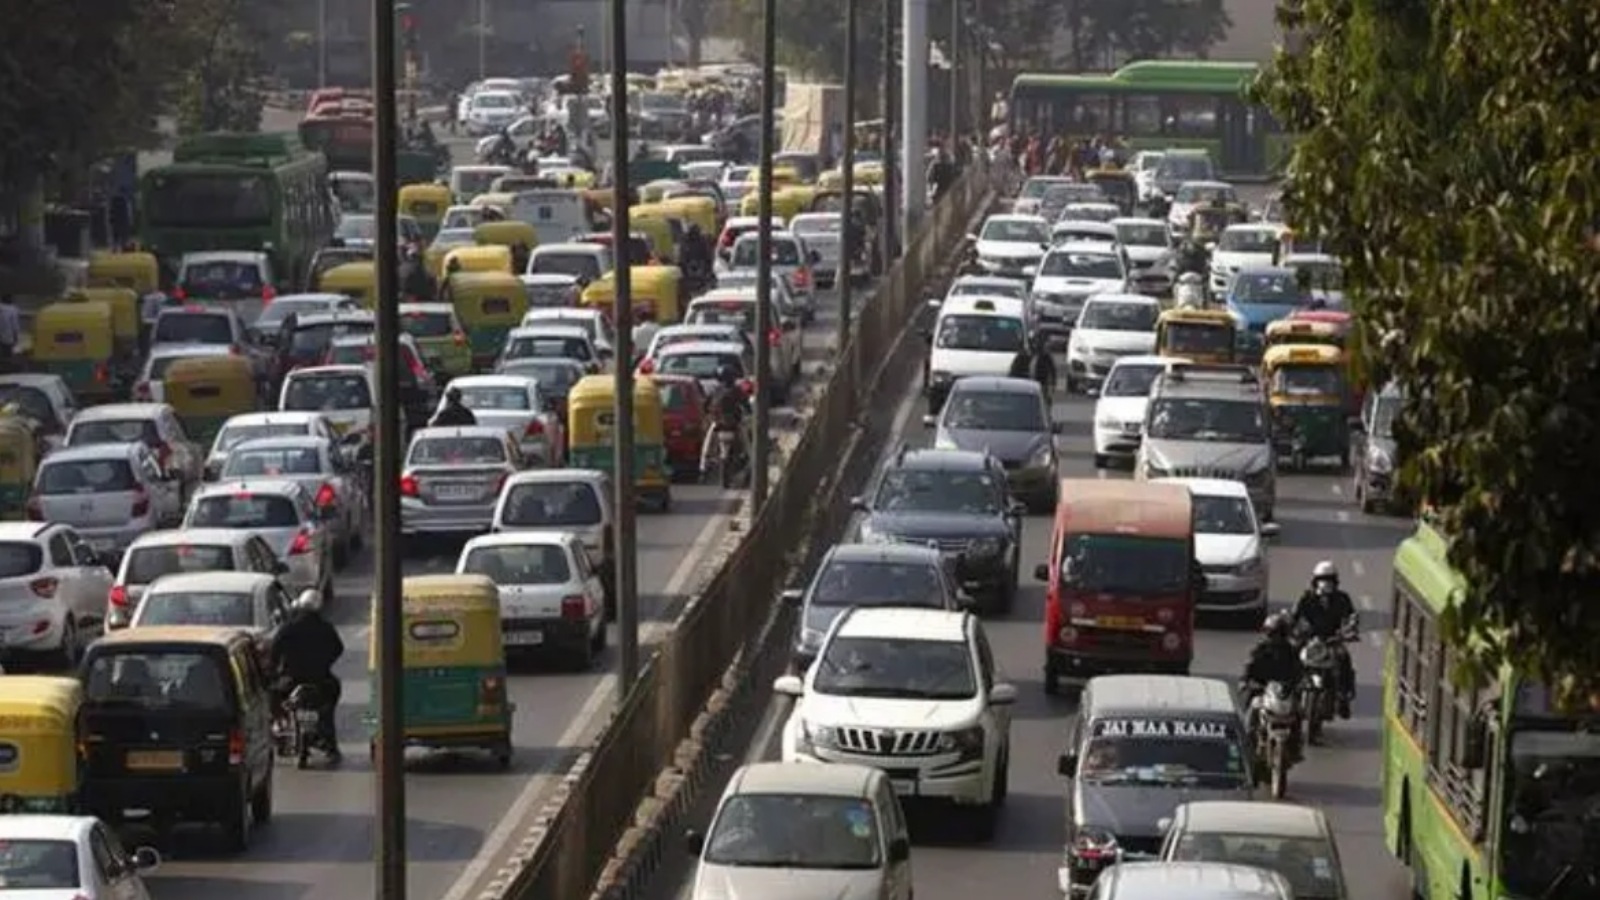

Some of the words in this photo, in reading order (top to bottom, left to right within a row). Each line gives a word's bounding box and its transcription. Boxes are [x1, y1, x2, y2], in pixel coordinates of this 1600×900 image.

[1101, 720, 1127, 736] JAI
[1132, 721, 1169, 736] MAA
[1174, 721, 1226, 738] KAALI
